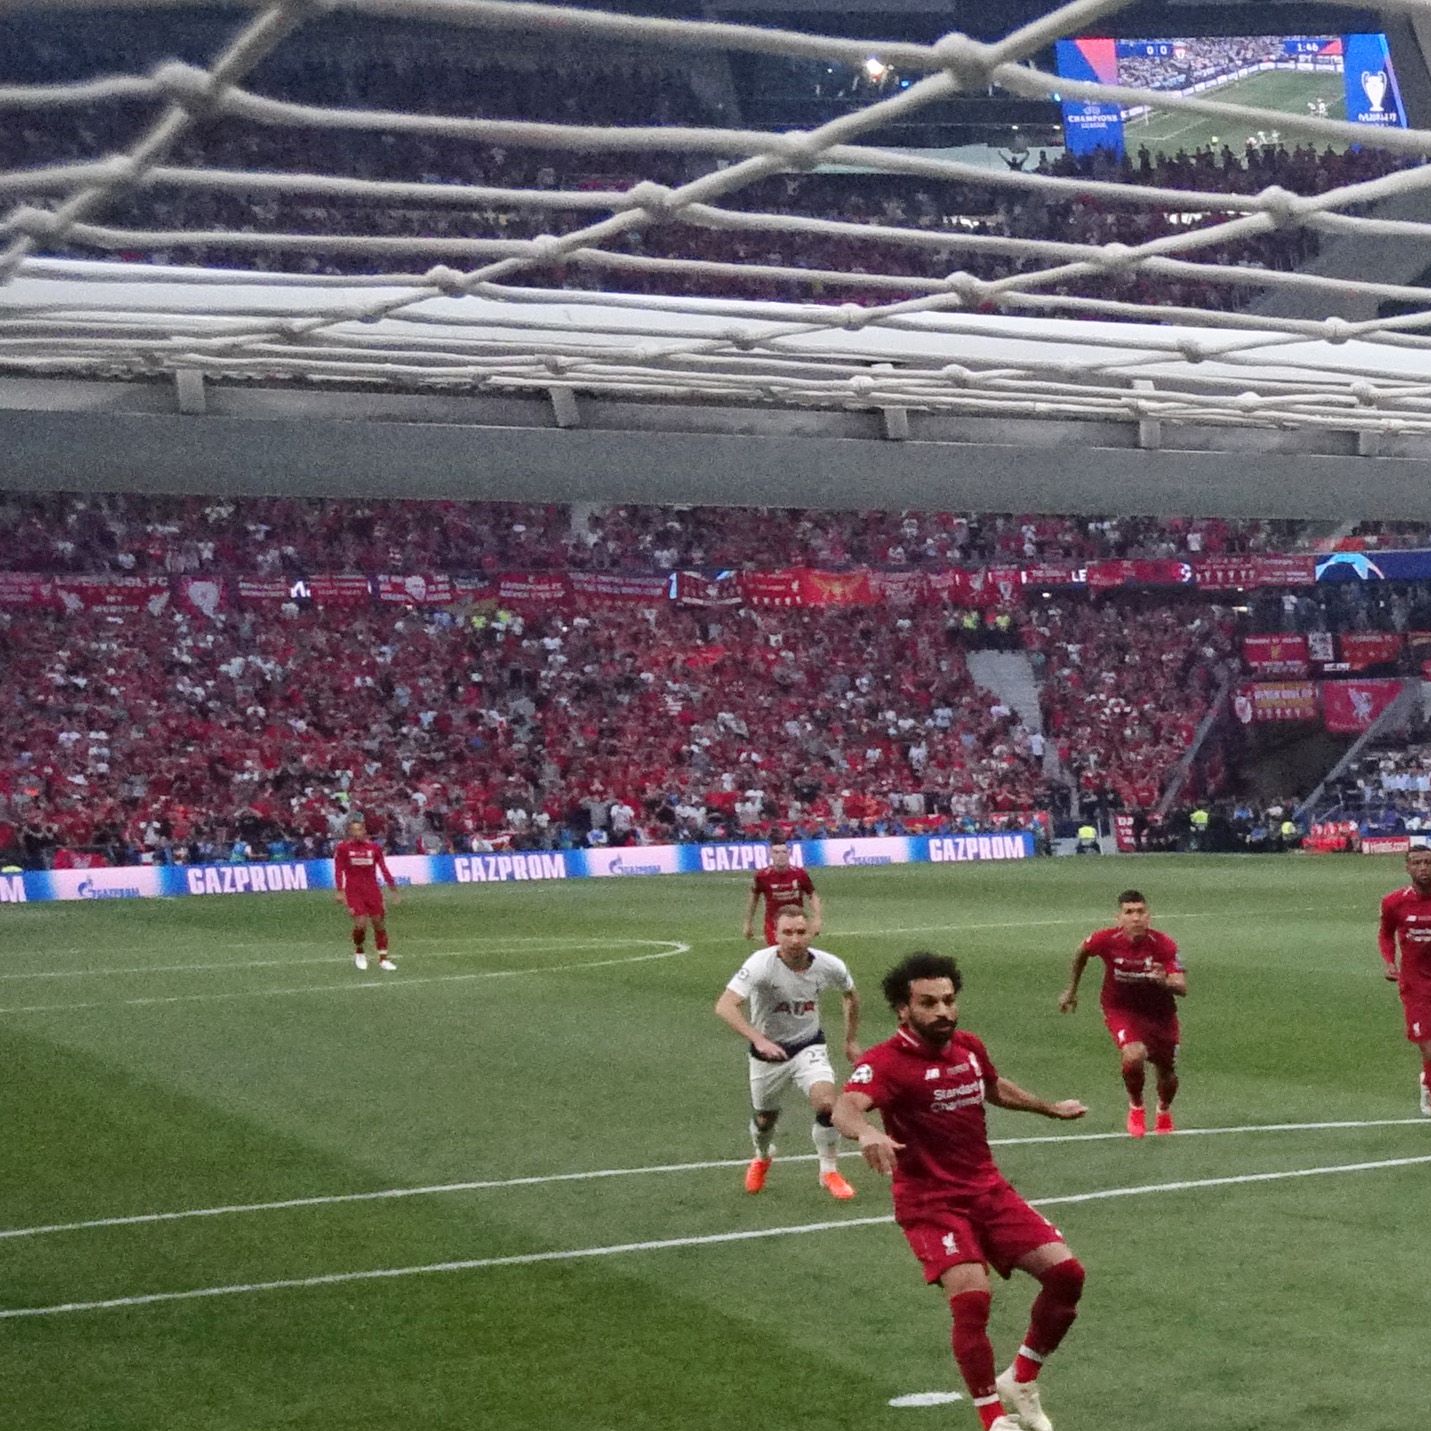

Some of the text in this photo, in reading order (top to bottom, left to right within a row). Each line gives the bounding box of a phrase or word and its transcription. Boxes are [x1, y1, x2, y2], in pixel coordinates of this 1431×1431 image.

[1146, 45, 1168, 55] 0 0
[701, 844, 804, 871] GAZPRM
[929, 834, 1025, 862] GAZPROM
[187, 863, 308, 894] GAZPROM
[454, 853, 566, 882] GAZPROM
